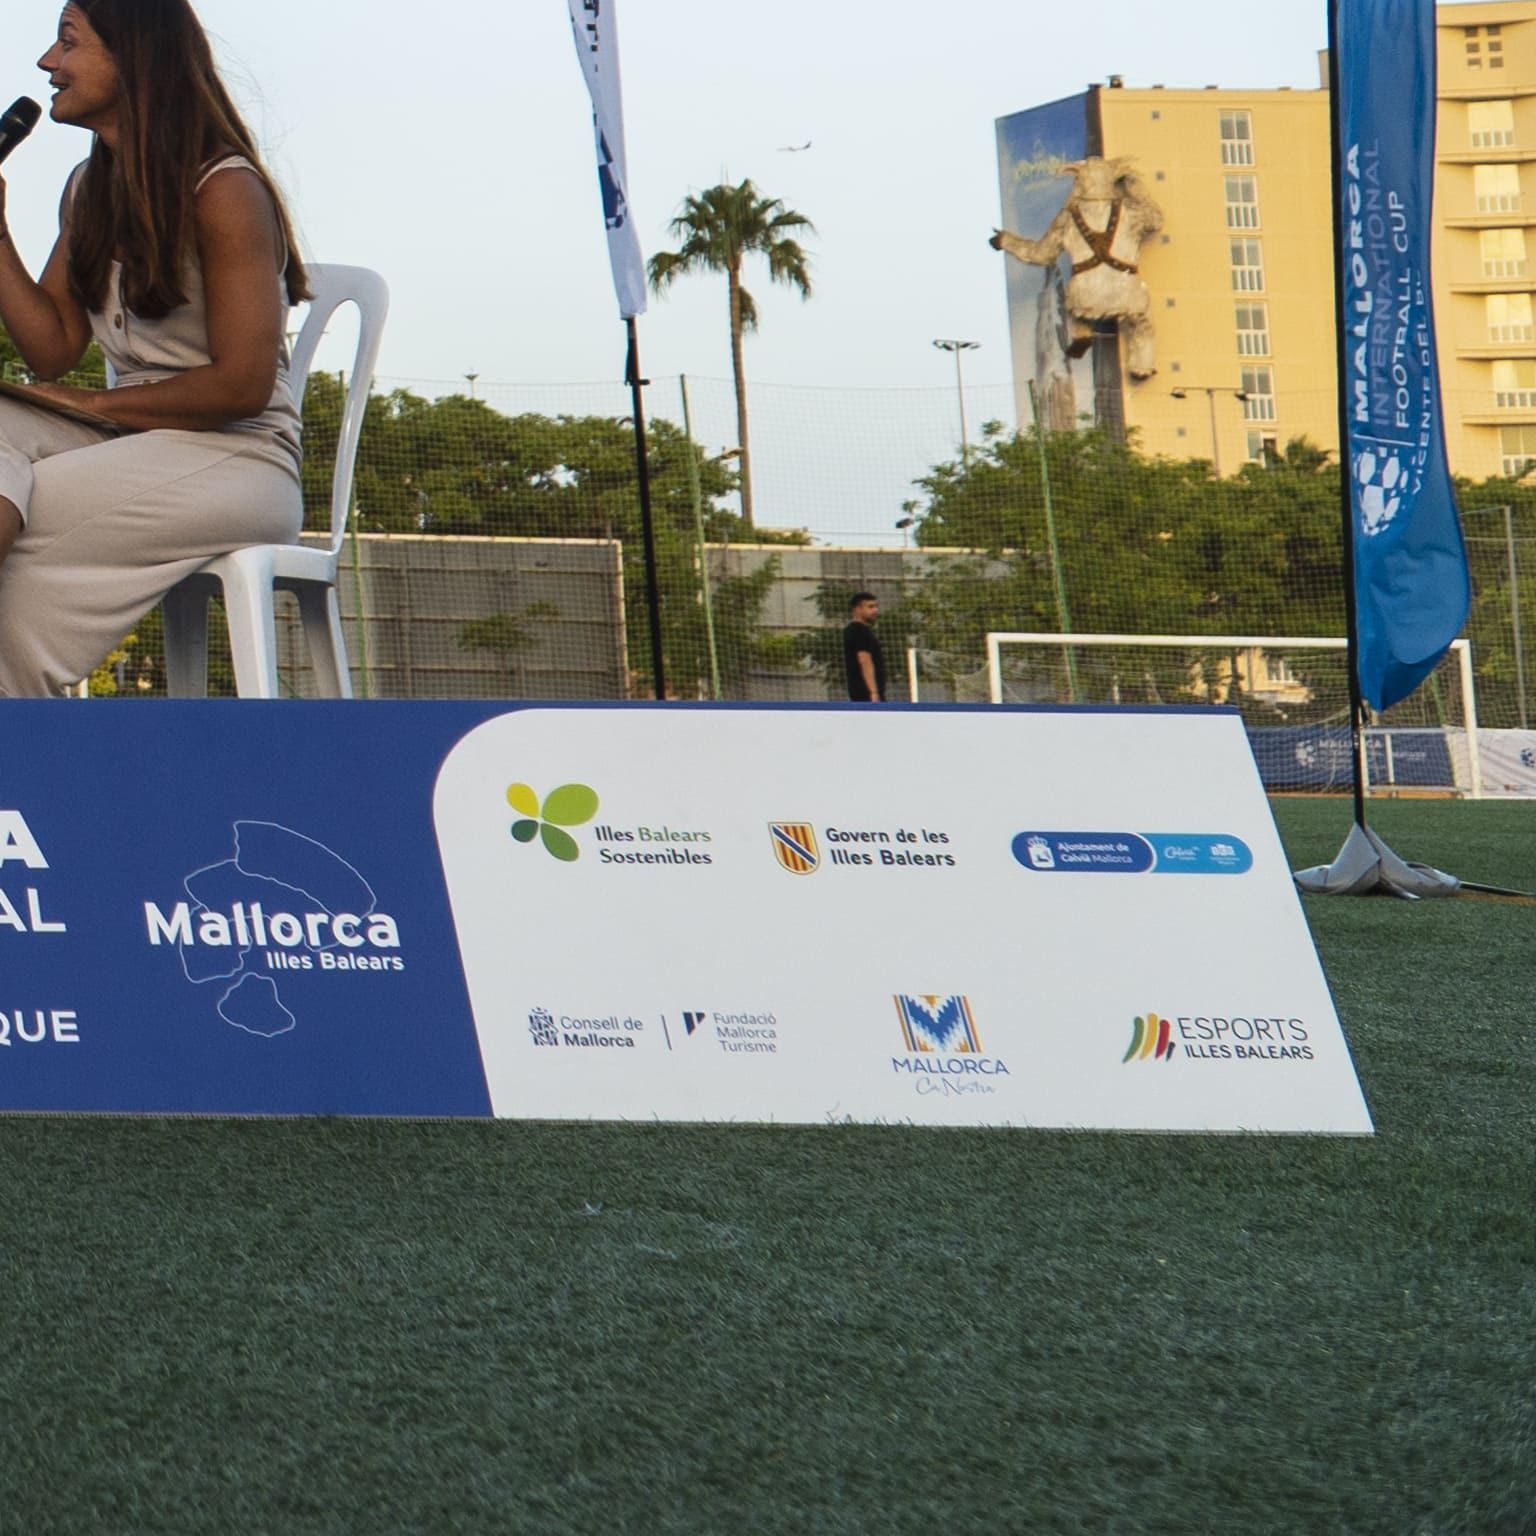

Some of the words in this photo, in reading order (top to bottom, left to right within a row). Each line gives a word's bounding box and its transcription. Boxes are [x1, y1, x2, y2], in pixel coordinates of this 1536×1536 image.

[1388, 190, 1410, 253] CUP
[1346, 143, 1374, 423] MALLORCA
[1364, 138, 1395, 426] INTERNATIONAL
[1392, 267, 1412, 429] FOOTBALL
[1413, 382, 1432, 495] VICENTE
[594, 826, 634, 842] Illes
[638, 827, 712, 842] Balears
[826, 828, 890, 843] Govern
[896, 829, 917, 843] de
[922, 829, 949, 844] les
[600, 848, 712, 865] Sostenibles
[830, 849, 873, 865] Illes
[879, 850, 955, 867] Balears
[144, 901, 401, 947] Mallorca
[267, 951, 313, 970] Illes
[319, 952, 404, 971] Balears
[560, 1015, 619, 1031] Consell
[624, 1017, 643, 1031] de
[713, 1012, 776, 1025] Fundació
[716, 1026, 776, 1039] Mallorca
[1178, 1017, 1308, 1041] ESPORTS
[564, 1033, 635, 1047] Mallorca
[719, 1040, 777, 1052] Turisme
[1184, 1044, 1232, 1059] ILLES
[1235, 1045, 1314, 1060] BALEARS
[892, 1058, 1010, 1074] MALLORCA
